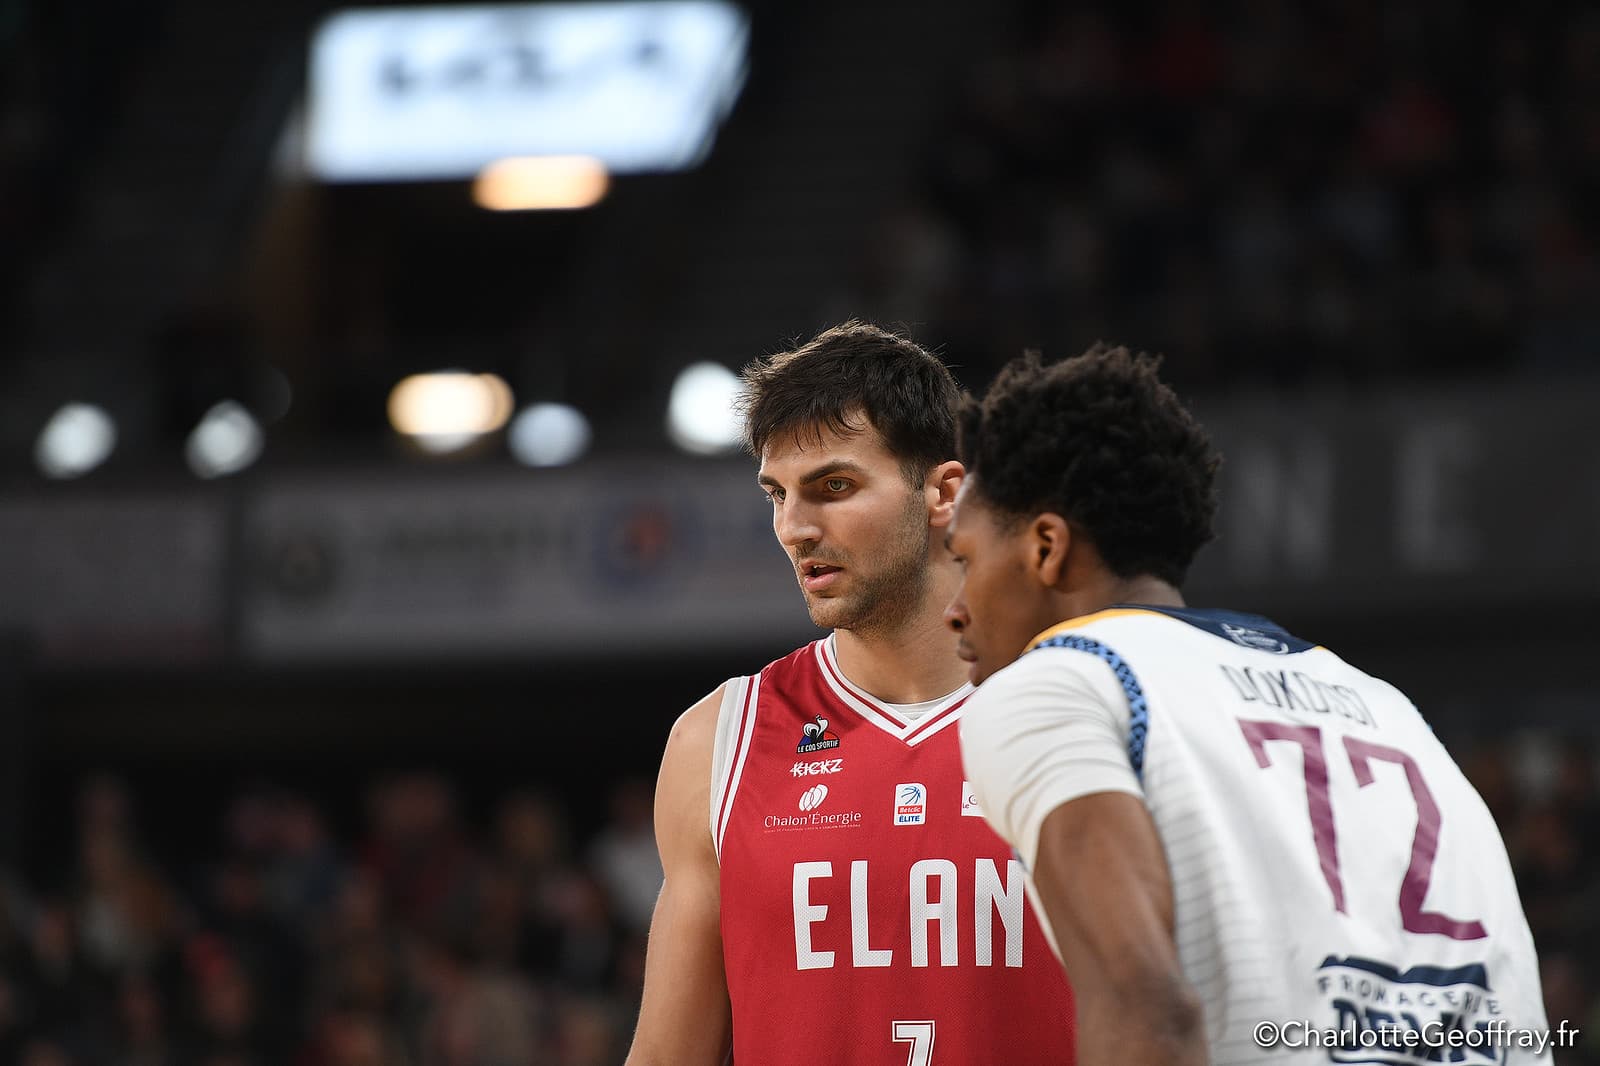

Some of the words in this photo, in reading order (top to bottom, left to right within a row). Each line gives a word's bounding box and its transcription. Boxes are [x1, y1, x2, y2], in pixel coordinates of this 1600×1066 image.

[797, 745, 805, 753] LE
[805, 743, 817, 752] COQ
[816, 740, 839, 750] SPORTIF
[764, 811, 862, 828] Chalon'Énergie
[898, 815, 921, 823] ÉLITE
[1236, 717, 1488, 942] 72
[793, 858, 1024, 970] ELAN
